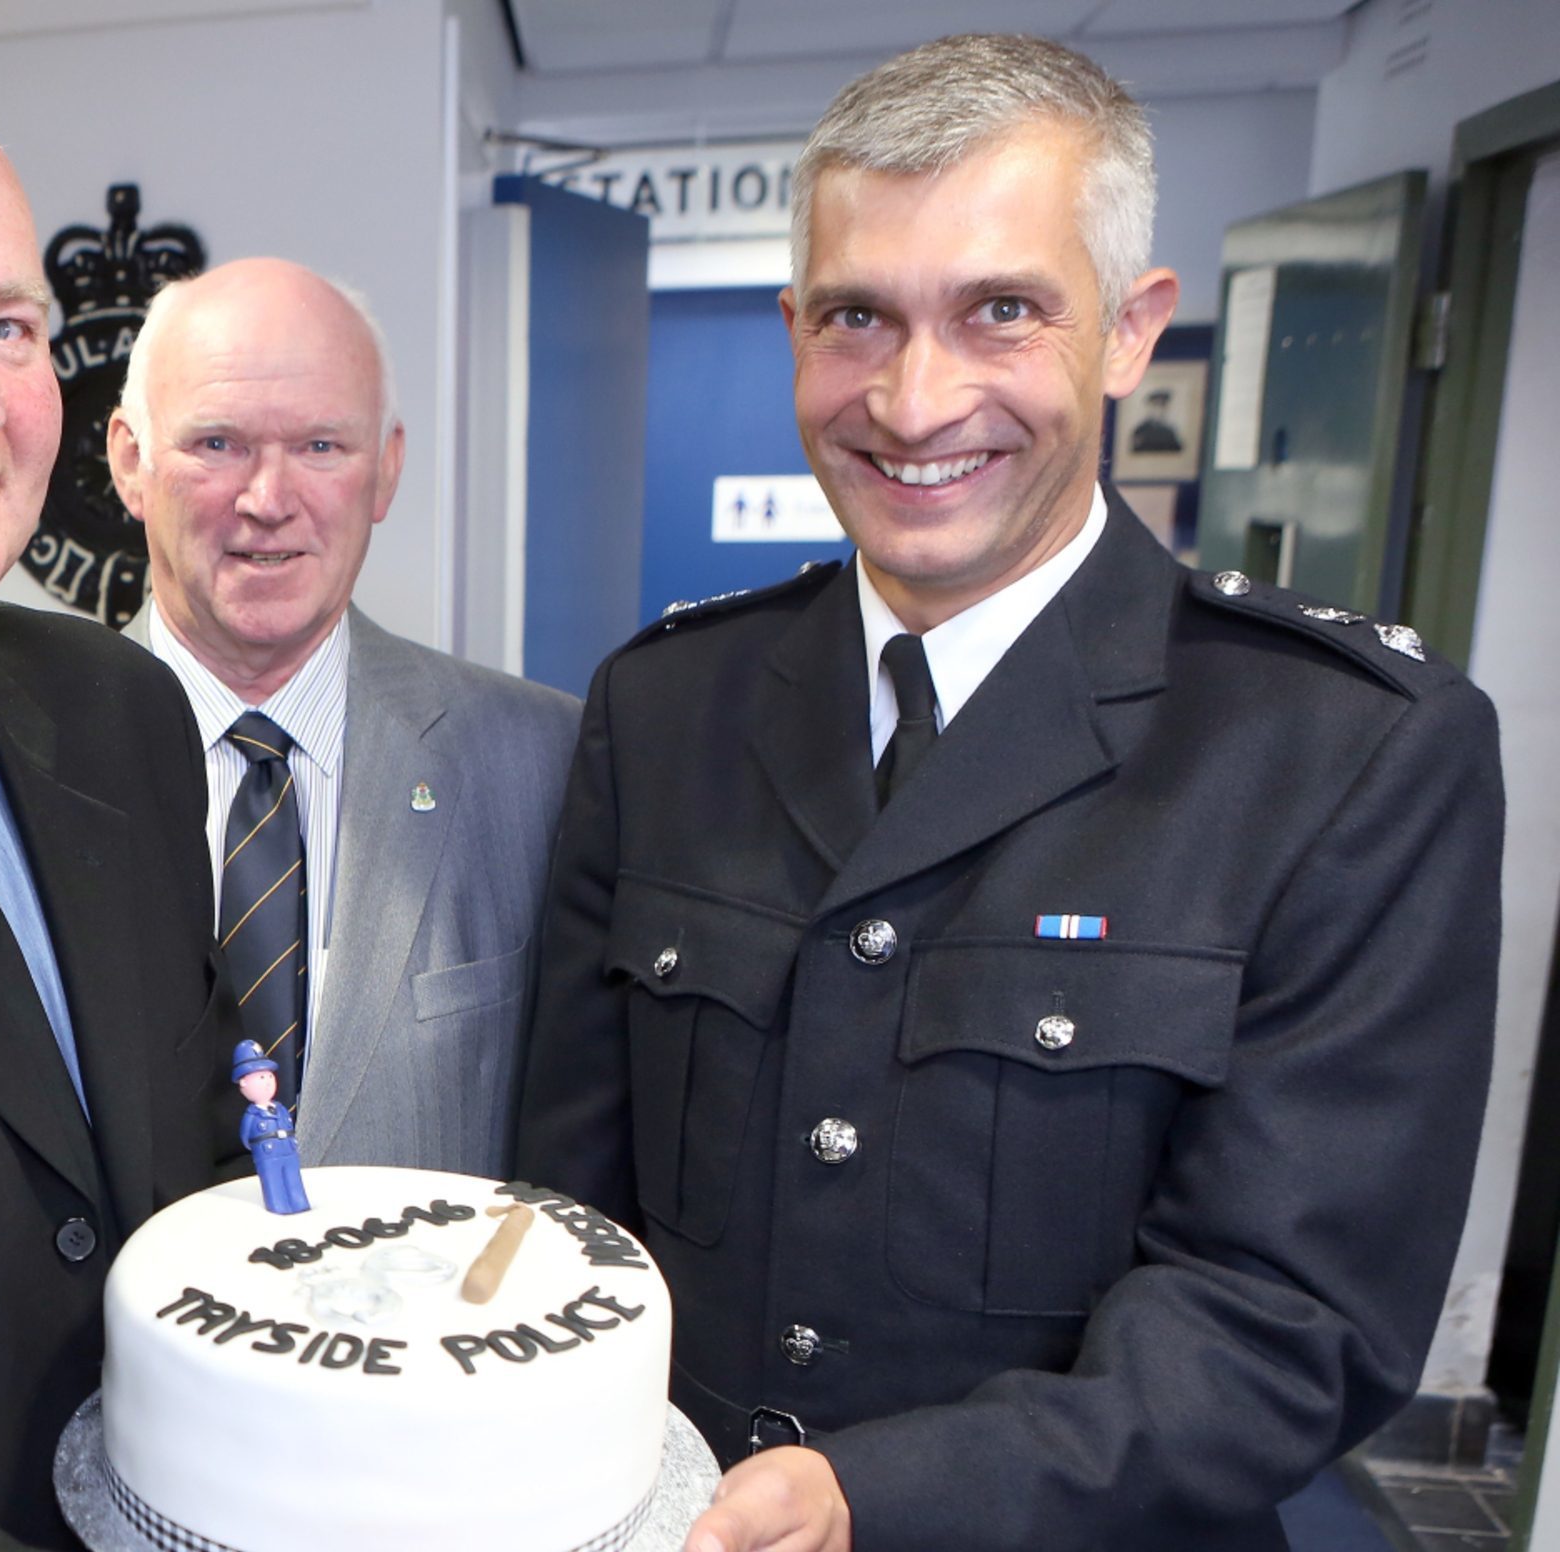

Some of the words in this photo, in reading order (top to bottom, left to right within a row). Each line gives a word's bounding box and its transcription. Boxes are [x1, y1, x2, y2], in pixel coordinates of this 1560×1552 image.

[248, 1199, 476, 1270] 18-06-16
[156, 1287, 408, 1375] TAYSIDE
[440, 1286, 646, 1375] POLICE
